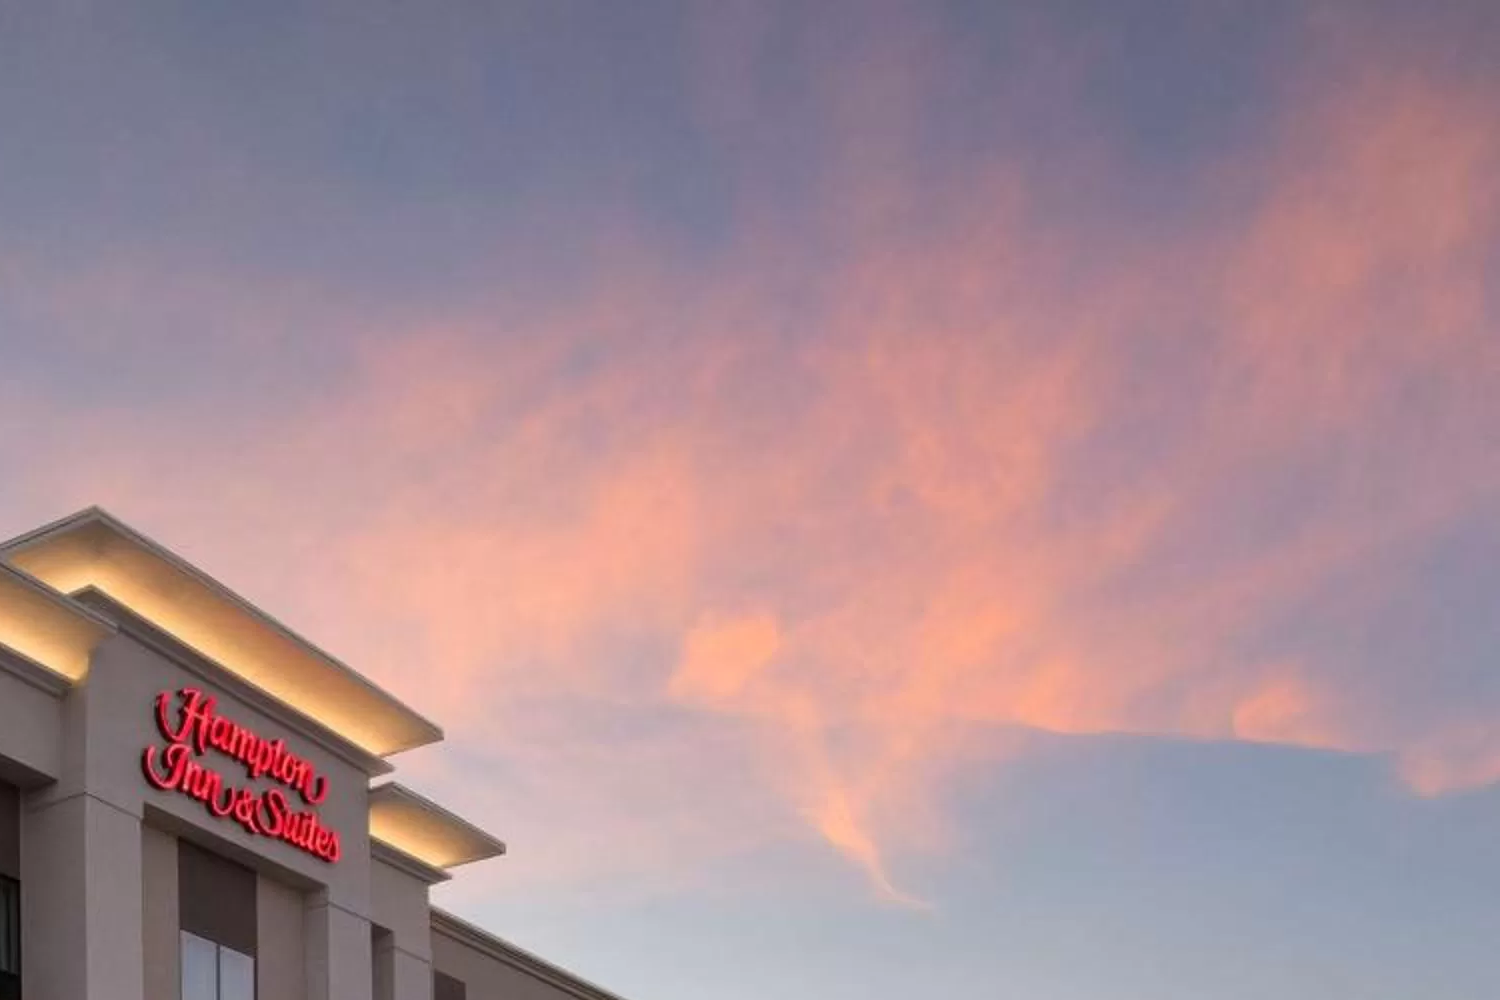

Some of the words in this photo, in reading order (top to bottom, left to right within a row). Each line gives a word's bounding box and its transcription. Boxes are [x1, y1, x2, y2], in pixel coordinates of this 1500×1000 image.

[142, 743, 236, 816] Inn
[255, 788, 341, 863] Suites
[155, 688, 328, 805] Hampton
